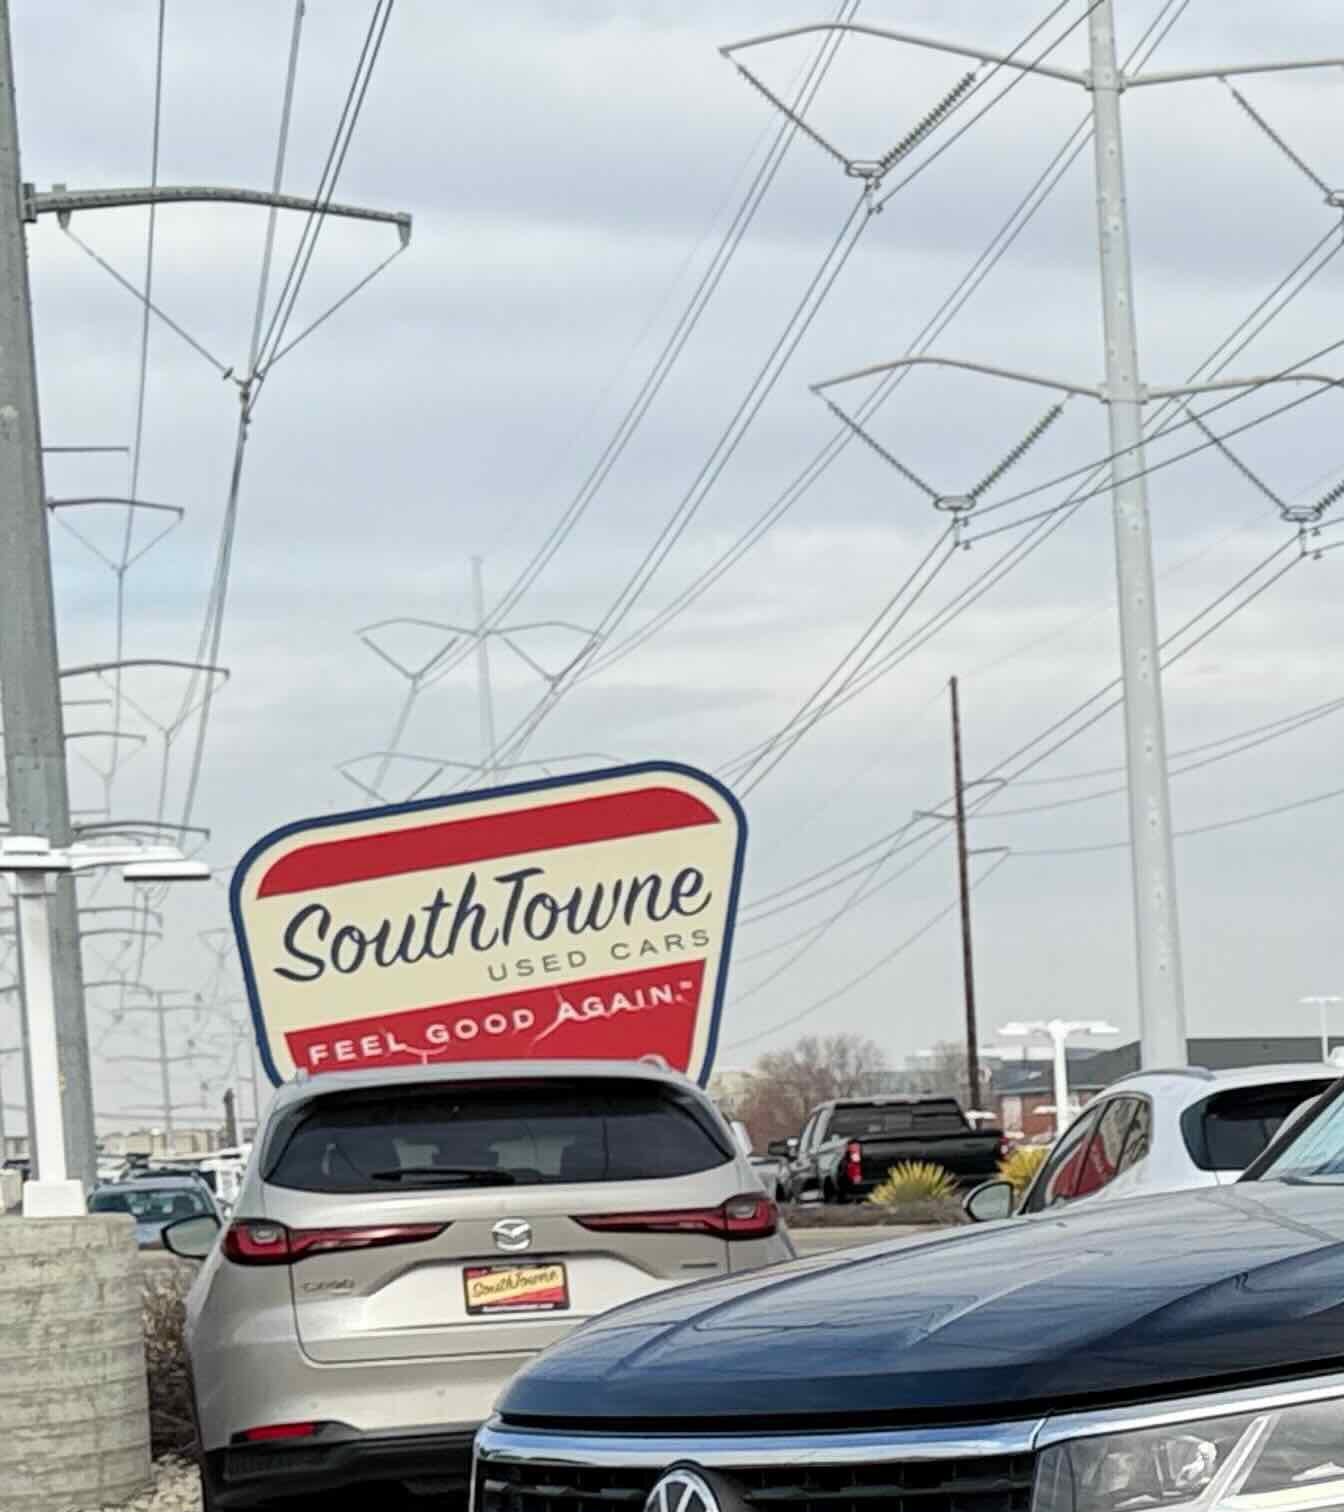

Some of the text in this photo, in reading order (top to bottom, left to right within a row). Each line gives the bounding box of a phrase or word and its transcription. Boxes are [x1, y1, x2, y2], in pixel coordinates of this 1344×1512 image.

[274, 866, 712, 982] SouthTowne
[487, 928, 711, 983] USED CARS
[308, 1032, 407, 1066] FEEL
[426, 1008, 534, 1044] GOOD
